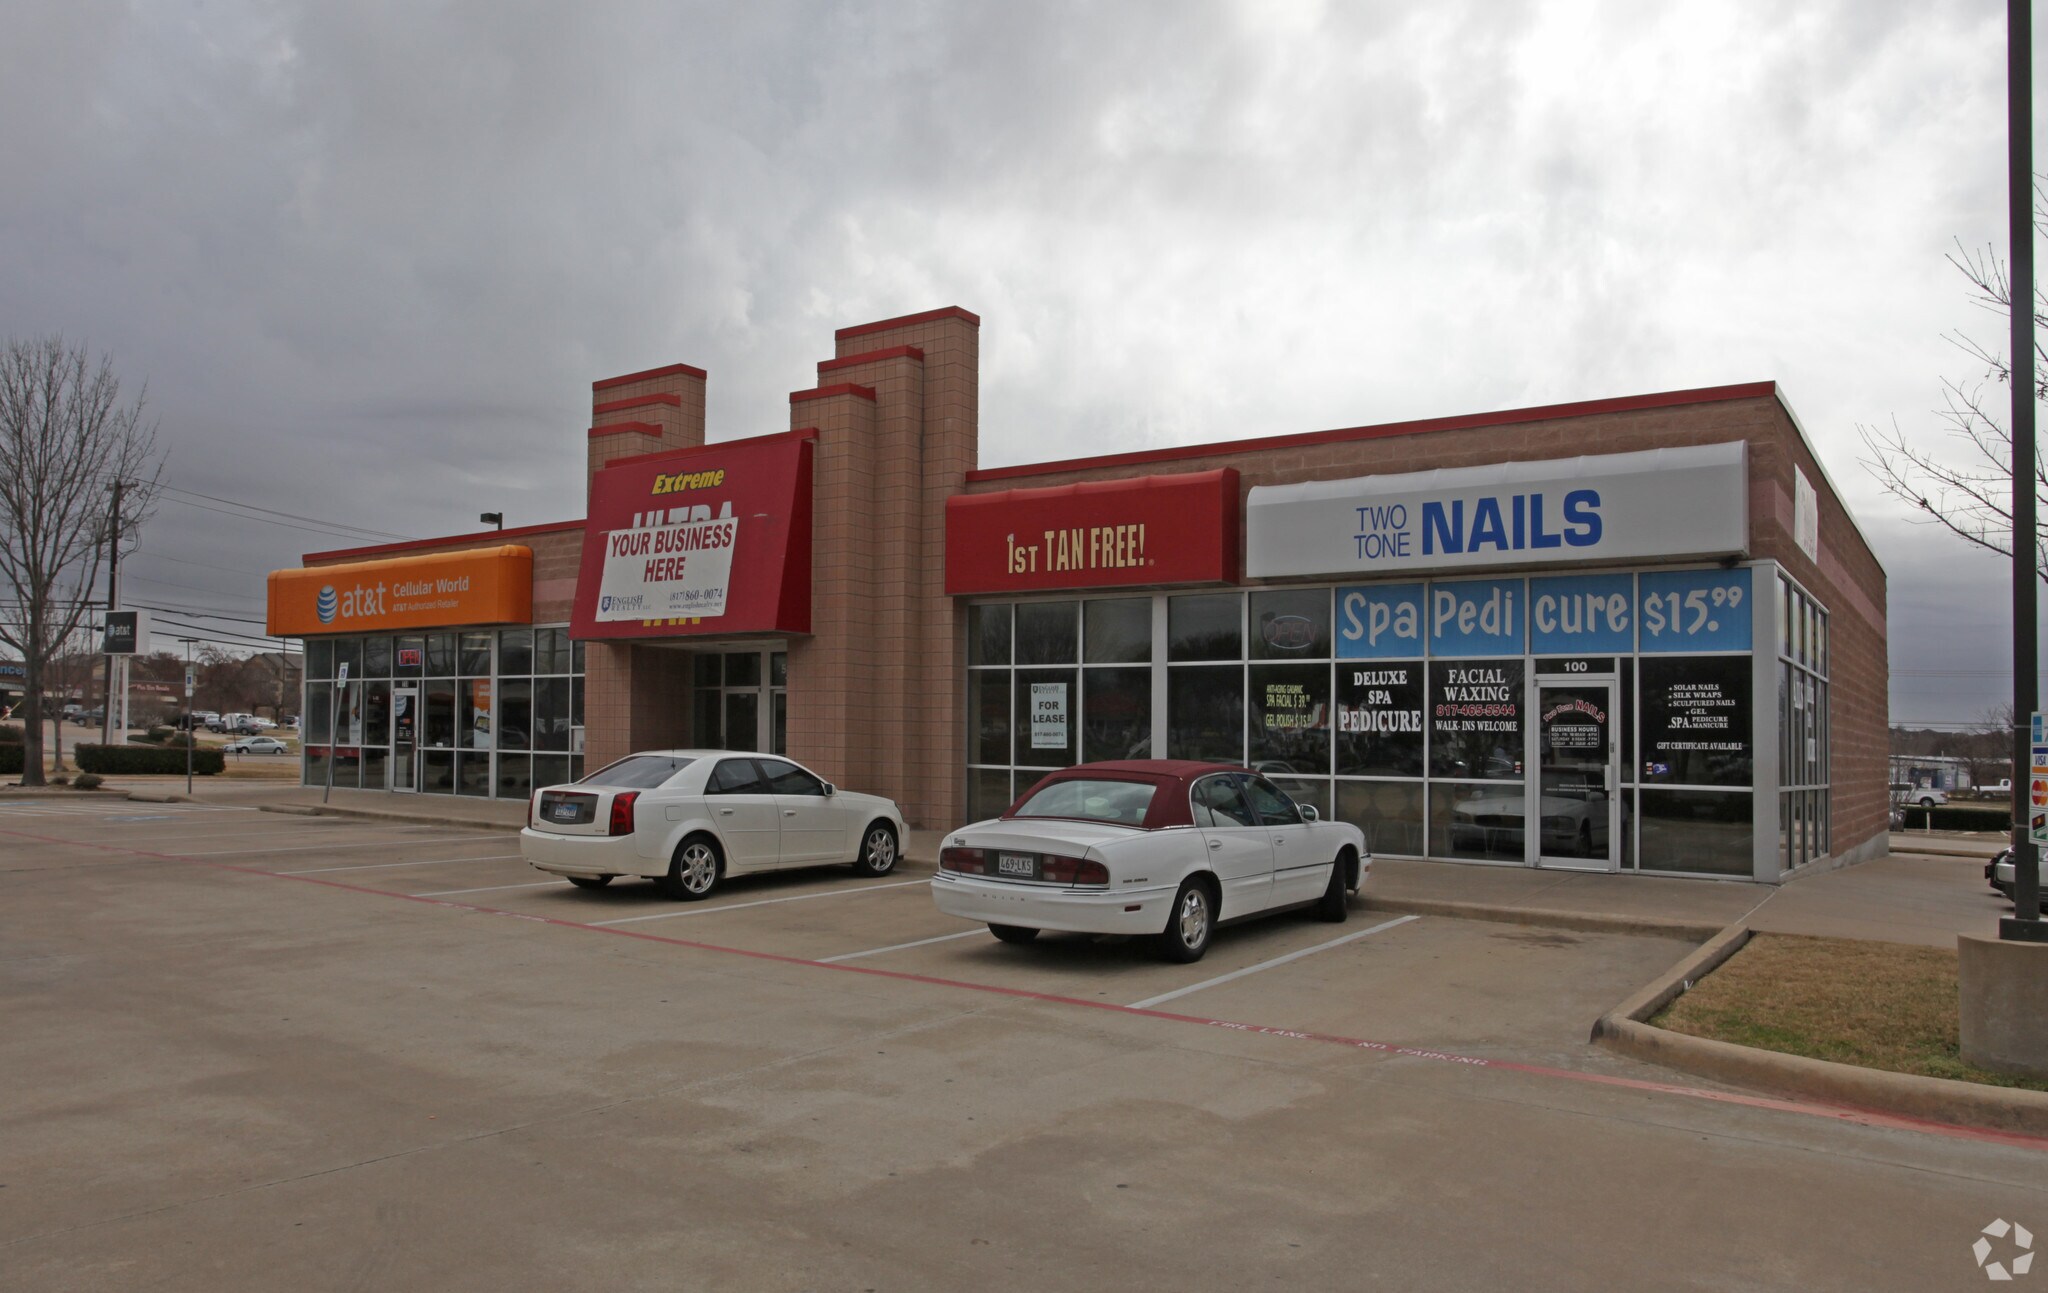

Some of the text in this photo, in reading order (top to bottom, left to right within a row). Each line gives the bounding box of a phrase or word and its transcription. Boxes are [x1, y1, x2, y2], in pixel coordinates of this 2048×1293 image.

[651, 468, 725, 496] Extreme
[1355, 504, 1408, 532] TWO
[1421, 489, 1603, 556] NAILS
[611, 523, 734, 558] YOUR BUSINESS
[1044, 528, 1084, 572] TAN
[1090, 523, 1145, 569] FREE!
[1353, 531, 1411, 560] TONE
[643, 556, 686, 583] HERE
[393, 576, 470, 598] Cellular World
[341, 581, 387, 618] at&t
[392, 603, 408, 612] AT&T
[612, 595, 644, 605] ENGLISH
[1341, 590, 1419, 647] Spa
[1433, 588, 1513, 639] Pedi
[1534, 587, 1629, 635] cure
[1563, 662, 1588, 672] 100
[1353, 670, 1408, 686] DELUXE
[1448, 668, 1506, 685] FACIAL
[1266, 694, 1276, 707] SPA
[1276, 694, 1292, 708] FACIAL
[1368, 690, 1392, 705] SPA
[1443, 686, 1511, 702] WAXING
[1038, 701, 1059, 710] FOR
[1436, 704, 1516, 717] 817-465-5544
[1575, 699, 1605, 723] NAILS
[1033, 714, 1065, 723] LEASE
[1266, 713, 1275, 727] GEL
[1276, 713, 1294, 728] POLISH
[1339, 710, 1422, 732] PEDICURE
[1477, 721, 1518, 731] WELCOME
[1671, 716, 1690, 729] SPA
[1656, 741, 1743, 750] GIFT CERTIFICATE AVAILABLE
[2034, 755, 2047, 766] VISA
[1209, 1020, 1489, 1066] FIRE LANE NO PARKING
